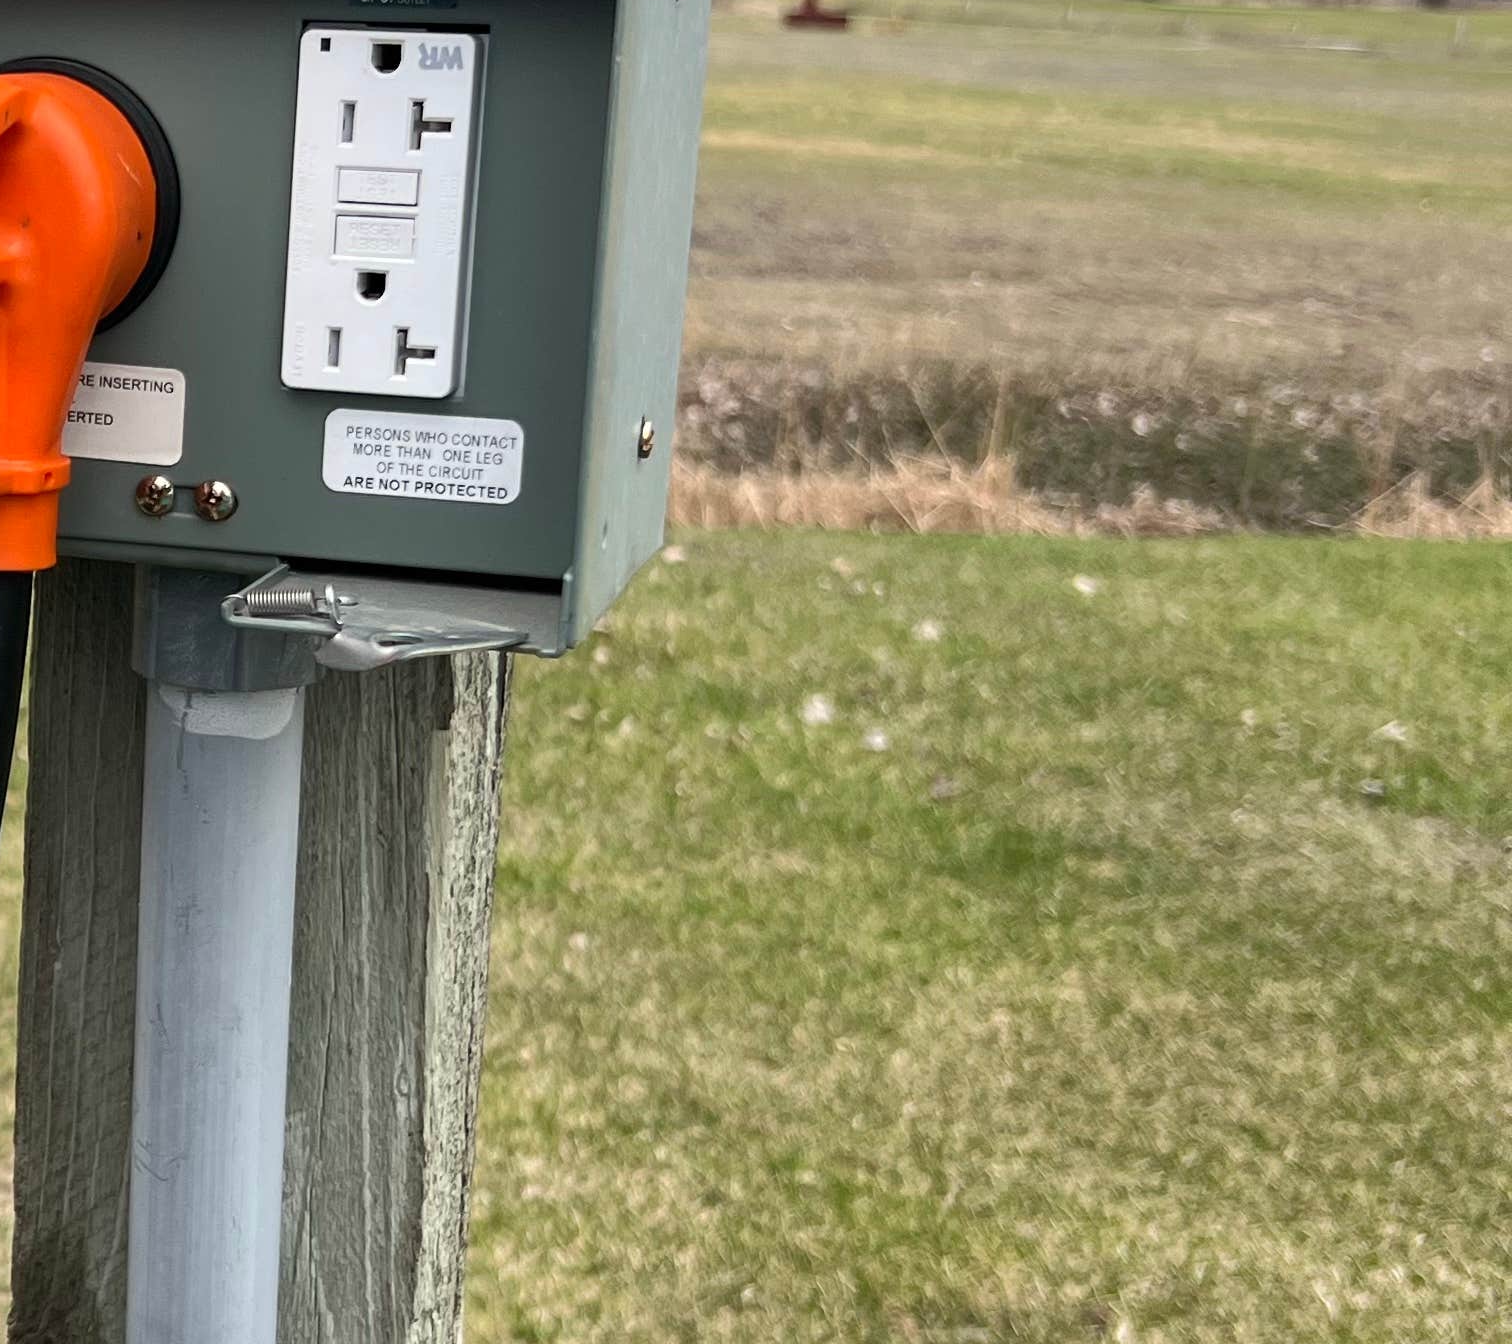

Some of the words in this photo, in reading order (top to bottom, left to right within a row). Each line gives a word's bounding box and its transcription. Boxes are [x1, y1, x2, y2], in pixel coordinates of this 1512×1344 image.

[418, 42, 464, 70] WR
[99, 375, 173, 393] INSERTING
[346, 425, 410, 442] PERSONS
[415, 430, 447, 444] WHO
[451, 433, 517, 449] CONTACT
[353, 442, 391, 457] MORE
[396, 445, 431, 459] THAN
[442, 449, 471, 463] ONE
[476, 447, 502, 465] LEG
[376, 460, 394, 474] OF
[398, 462, 423, 476] THE
[428, 464, 483, 481] CIRCUIT
[343, 475, 374, 489] ARE
[378, 478, 409, 492] NOT
[414, 481, 507, 499] PROTECTED
